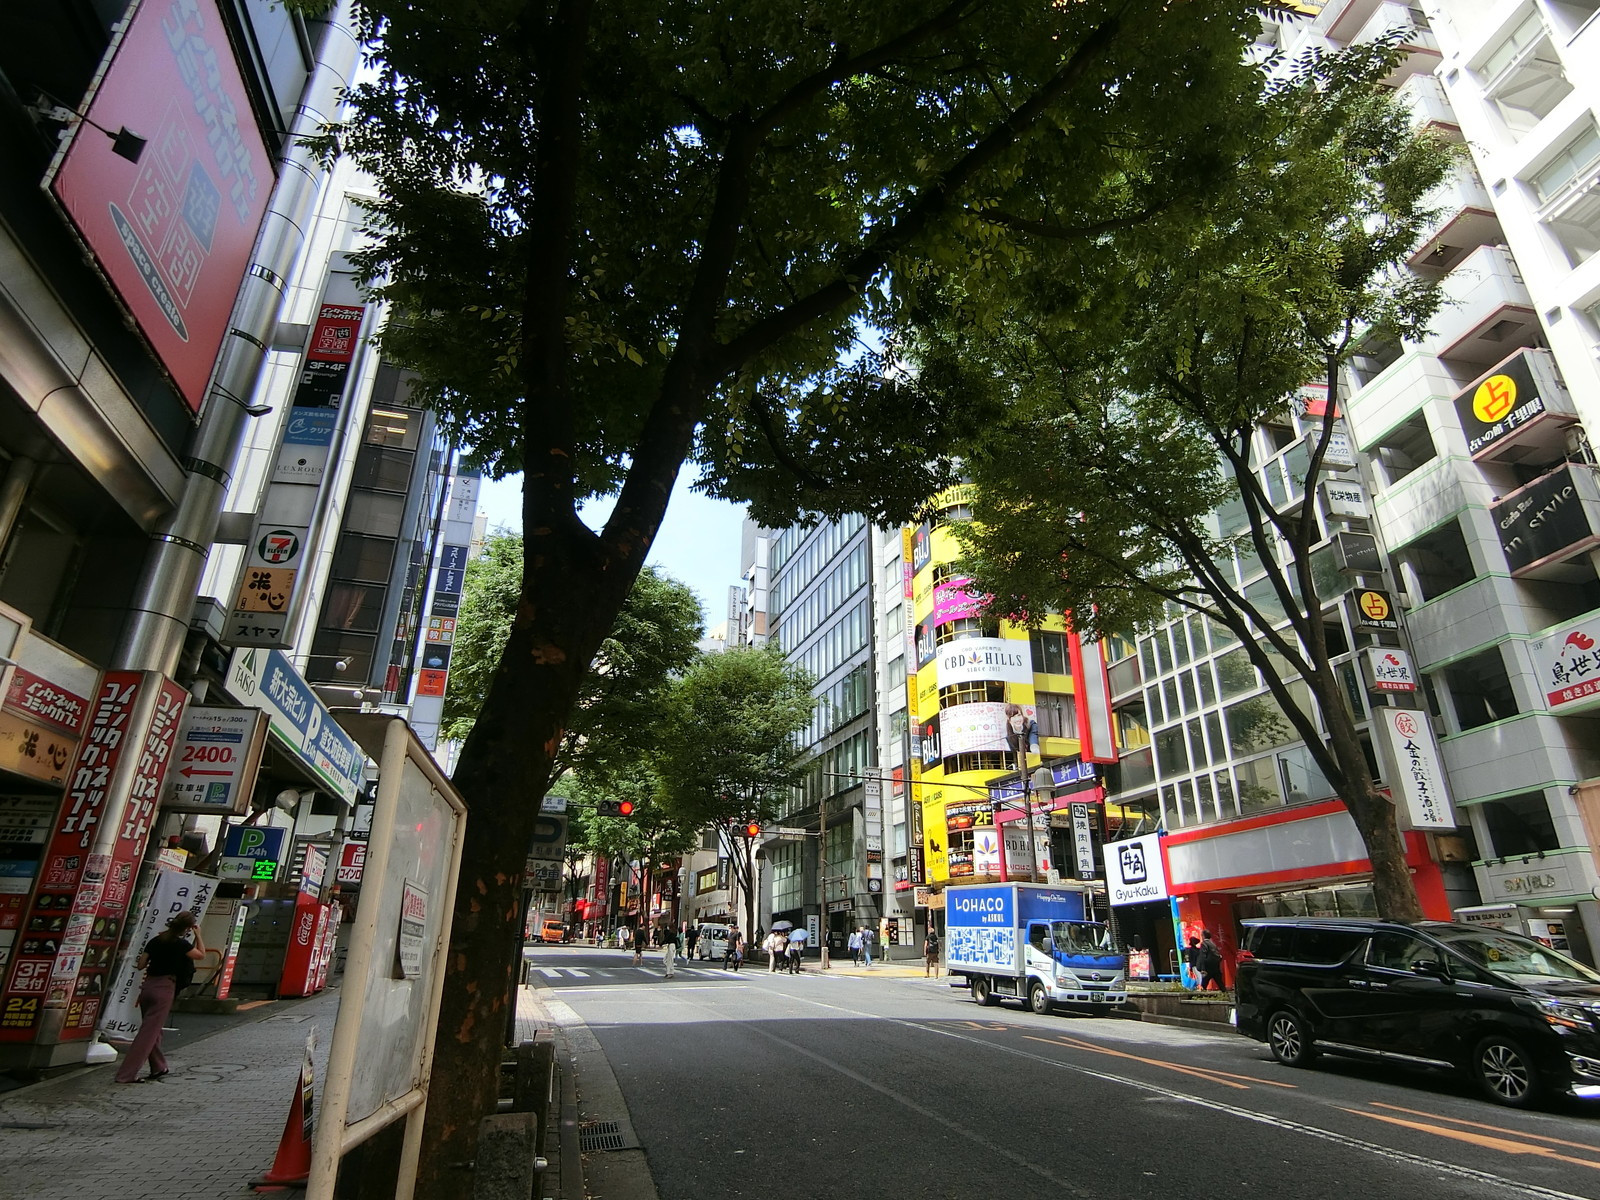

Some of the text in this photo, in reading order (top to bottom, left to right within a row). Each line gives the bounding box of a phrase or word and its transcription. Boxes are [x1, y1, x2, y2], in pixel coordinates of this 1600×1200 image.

[119, 223, 182, 327] space create
[1482, 381, 1510, 420] 占
[1366, 593, 1385, 617] 占
[236, 625, 281, 639] スヤマ
[944, 652, 1023, 670] CBD HILLS
[234, 666, 257, 697] TAISO
[61, 682, 120, 833] コミックカフェ
[181, 746, 237, 764] 2400円
[544, 798, 564, 806] 玄坂
[974, 811, 992, 826] 2F
[238, 828, 265, 857] P
[248, 847, 268, 857] 24h
[1116, 886, 1159, 902] Gyu-Kaku
[955, 897, 1004, 912] LOHACO
[987, 914, 1004, 923] ASKUL
[18, 962, 50, 978] 3F
[14, 977, 45, 990] 受付
[6, 998, 38, 1012] 24
[70, 1002, 97, 1015] 24 3F
[105, 1020, 139, 1035] 当ビル
